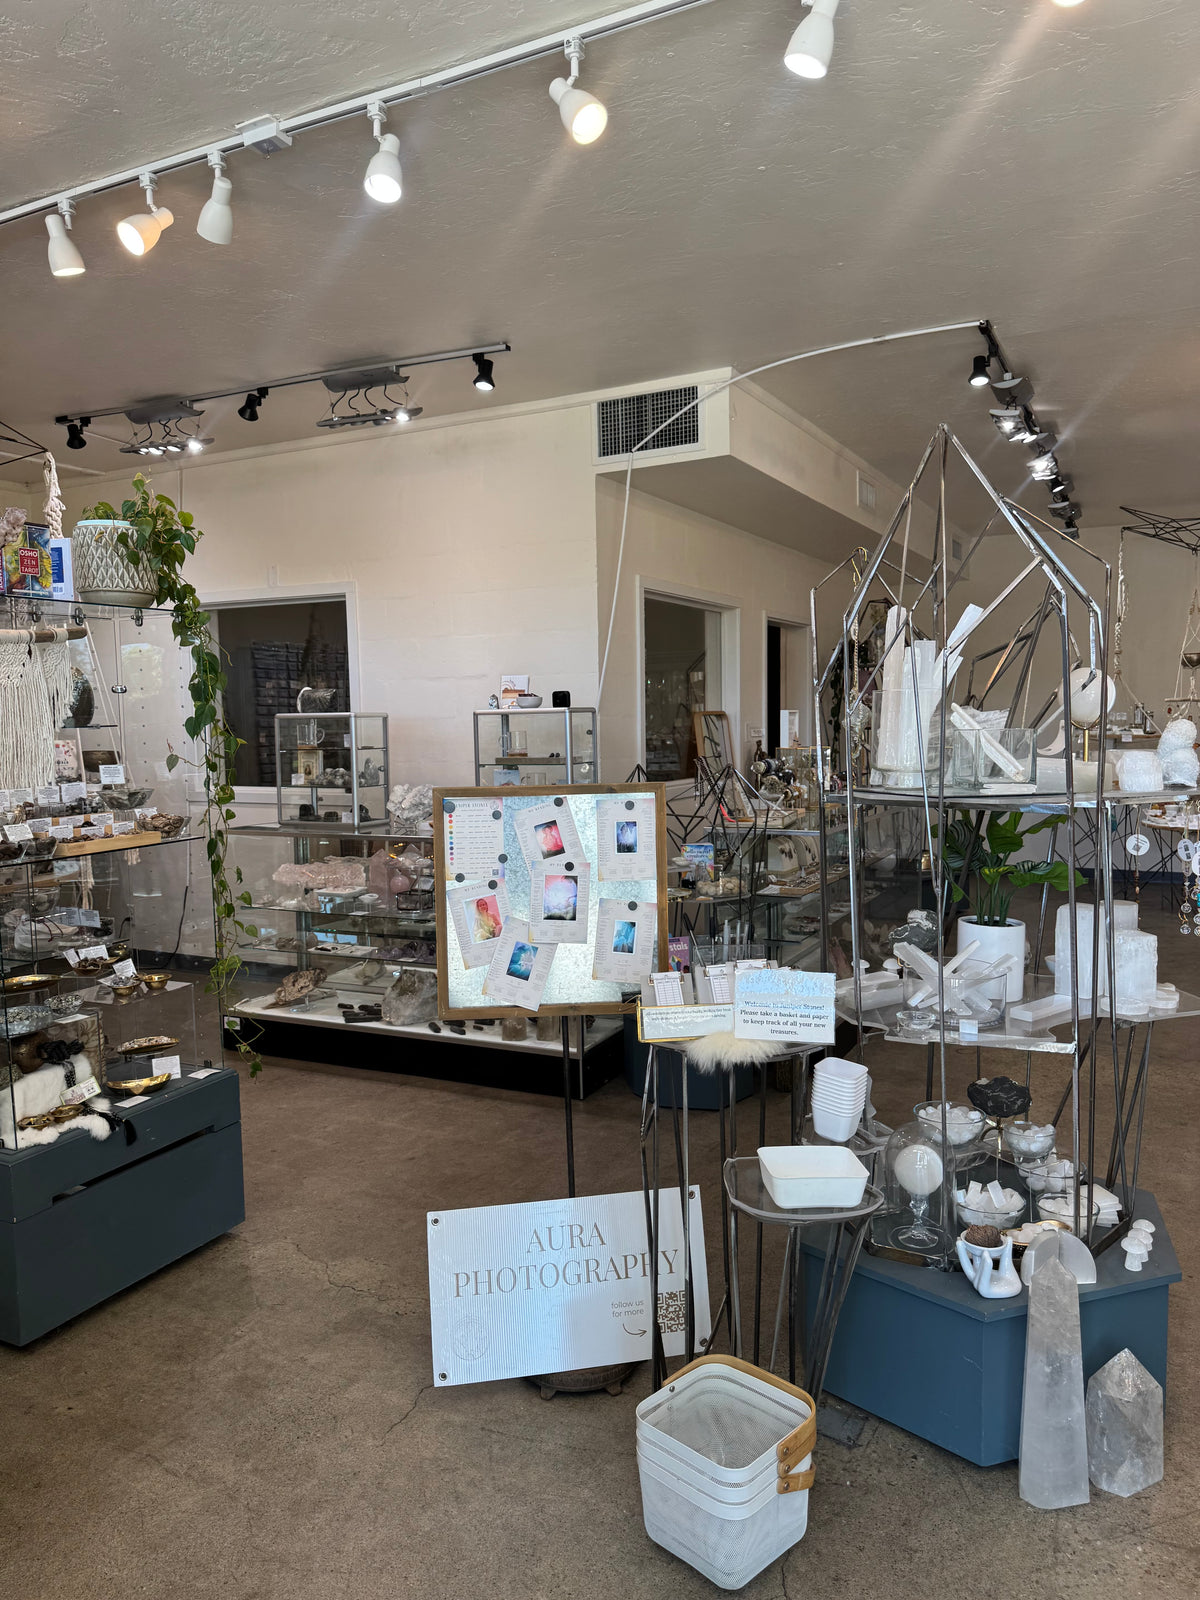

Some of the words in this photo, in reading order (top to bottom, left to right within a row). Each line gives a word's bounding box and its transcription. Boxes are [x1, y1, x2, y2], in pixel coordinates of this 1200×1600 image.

[20, 550, 38, 558] OSHO
[668, 942, 688, 951] stals
[750, 1018, 765, 1026] keep
[770, 1028, 799, 1036] treasures.
[526, 1221, 607, 1253] AURA
[453, 1248, 679, 1298] PHOTOGRAPHY
[611, 1300, 634, 1309] follow
[612, 1310, 622, 1318] for
[624, 1309, 645, 1317] more
